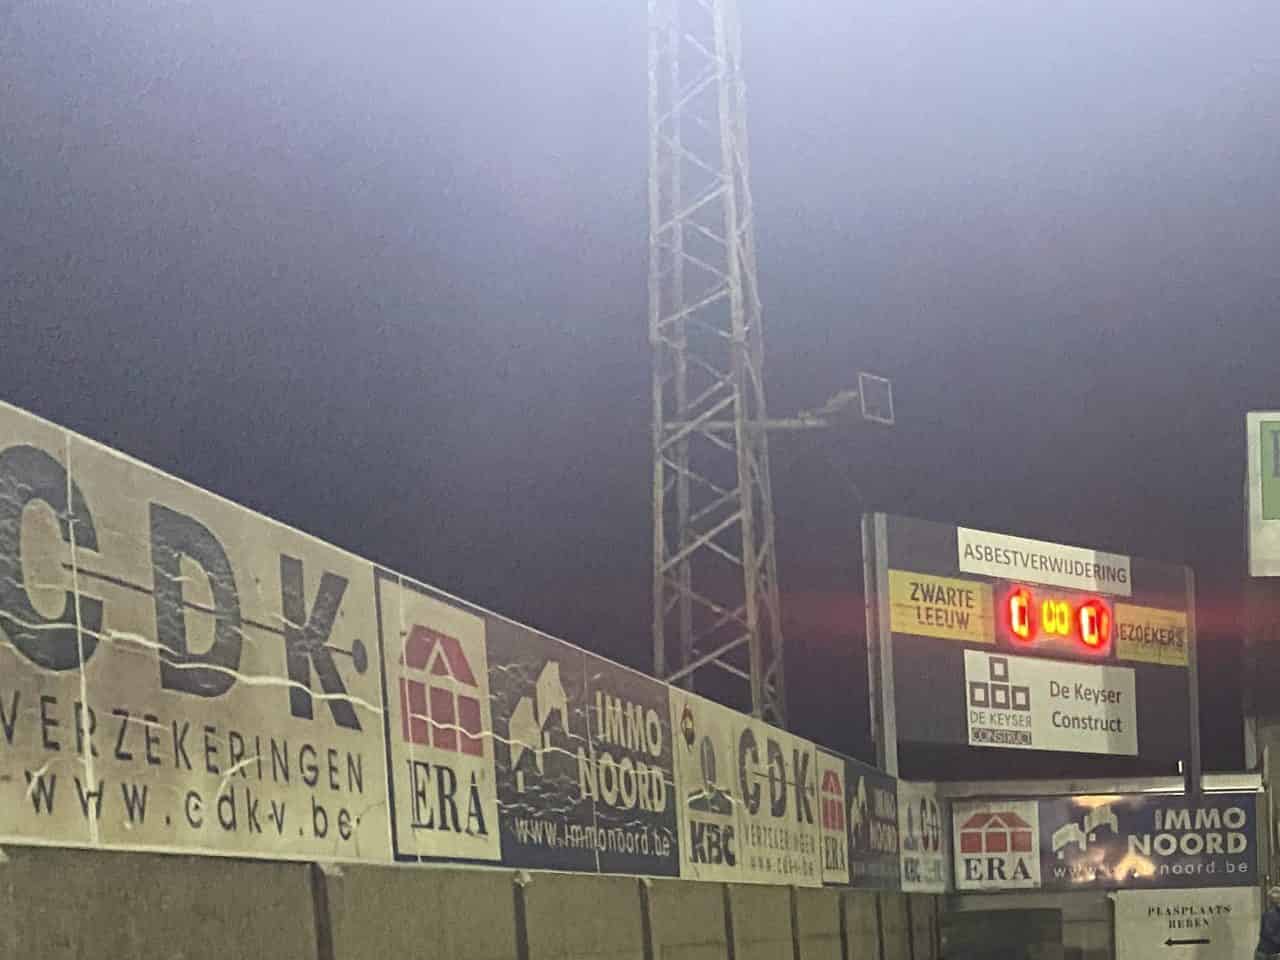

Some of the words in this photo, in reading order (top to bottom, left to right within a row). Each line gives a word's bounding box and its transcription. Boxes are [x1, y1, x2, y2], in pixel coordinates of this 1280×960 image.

[963, 543, 1128, 584] ASBESTVERWIJDERING
[0, 444, 362, 732] CDK
[909, 581, 974, 609] ZWARTE
[916, 605, 970, 630] LEEUW
[1049, 680, 1071, 699] De
[1074, 683, 1122, 704] Keyser
[595, 690, 662, 757] IMMO
[970, 710, 986, 725] DE
[989, 712, 1032, 728] KEYSER
[1052, 710, 1122, 733] Construct
[0, 689, 364, 794] VERZEKERINGEN
[577, 746, 667, 812] NOORD
[738, 727, 814, 825] CDK
[408, 758, 488, 836] ERA
[1154, 807, 1246, 831] IMMO
[689, 820, 736, 867] KBC
[1127, 832, 1248, 856] NOORD
[964, 857, 1033, 881] ERA
[1148, 904, 1232, 917] PLASPLAATS
